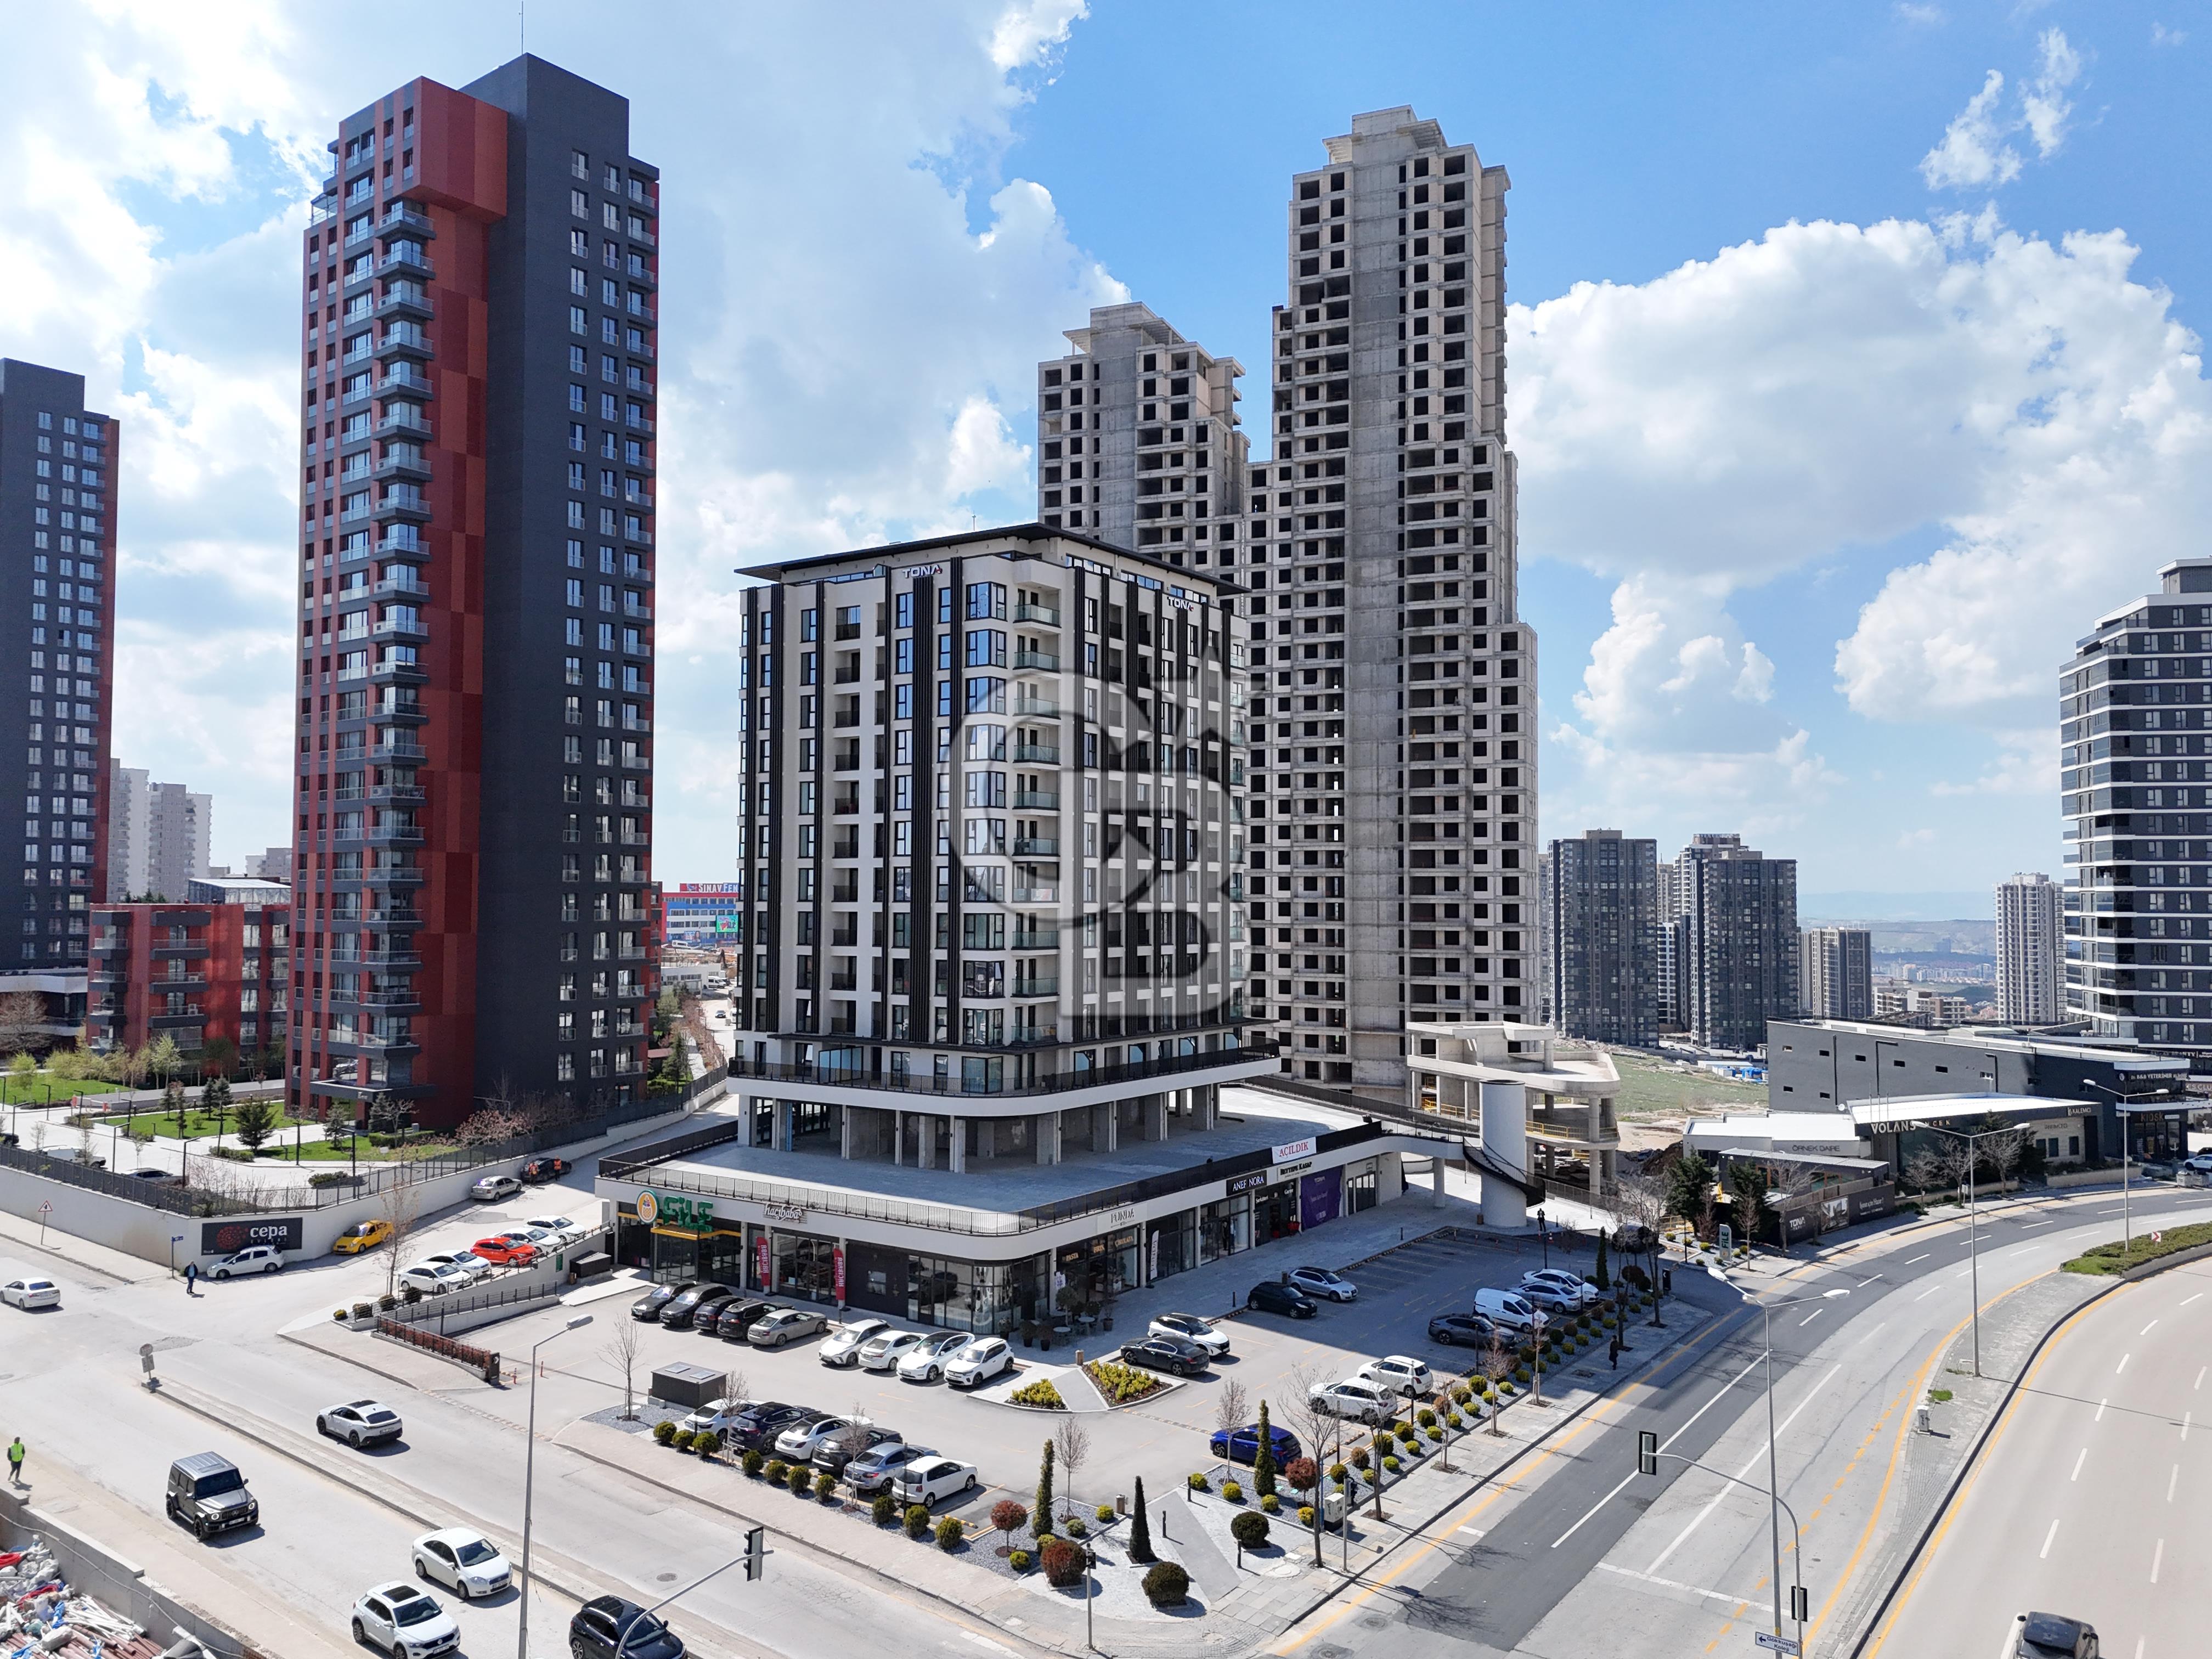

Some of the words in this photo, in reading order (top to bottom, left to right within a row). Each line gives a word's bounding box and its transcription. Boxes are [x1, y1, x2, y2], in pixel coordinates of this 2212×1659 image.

[902, 564, 943, 579] TONA
[1167, 596, 1194, 612] TONA
[699, 883, 722, 892] SINAV
[724, 883, 738, 892] FEN
[1870, 1120, 1916, 1135] VOLANS
[1279, 1142, 1309, 1158] AÇILDIK
[1233, 1180, 1247, 1192] ANEF
[1249, 1176, 1265, 1187] NORA
[1111, 1207, 1135, 1223] FUNDA
[1790, 1216, 1805, 1228] TONA
[250, 1226, 287, 1240] cepa
